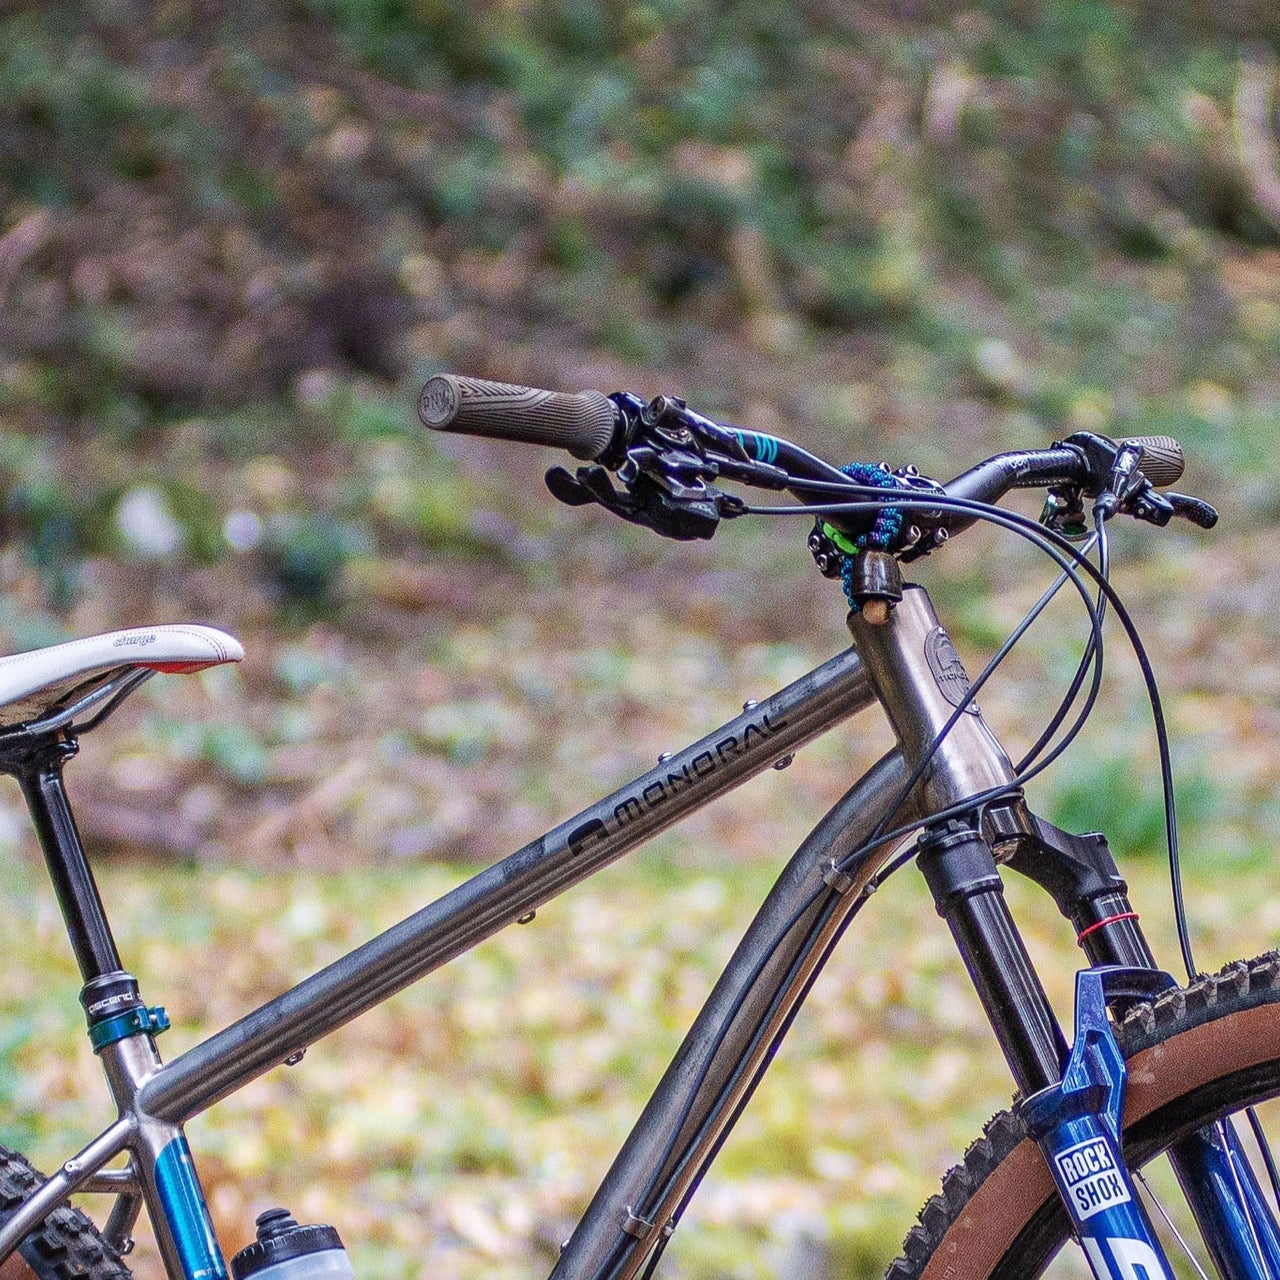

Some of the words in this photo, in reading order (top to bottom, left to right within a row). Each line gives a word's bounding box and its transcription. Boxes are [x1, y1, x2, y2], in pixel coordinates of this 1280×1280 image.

[113, 632, 157, 649] charge
[613, 714, 787, 828] MONORAL
[88, 991, 134, 1014] ascend
[1061, 1143, 1111, 1184] ROCK
[1075, 1173, 1123, 1211] SHOX
